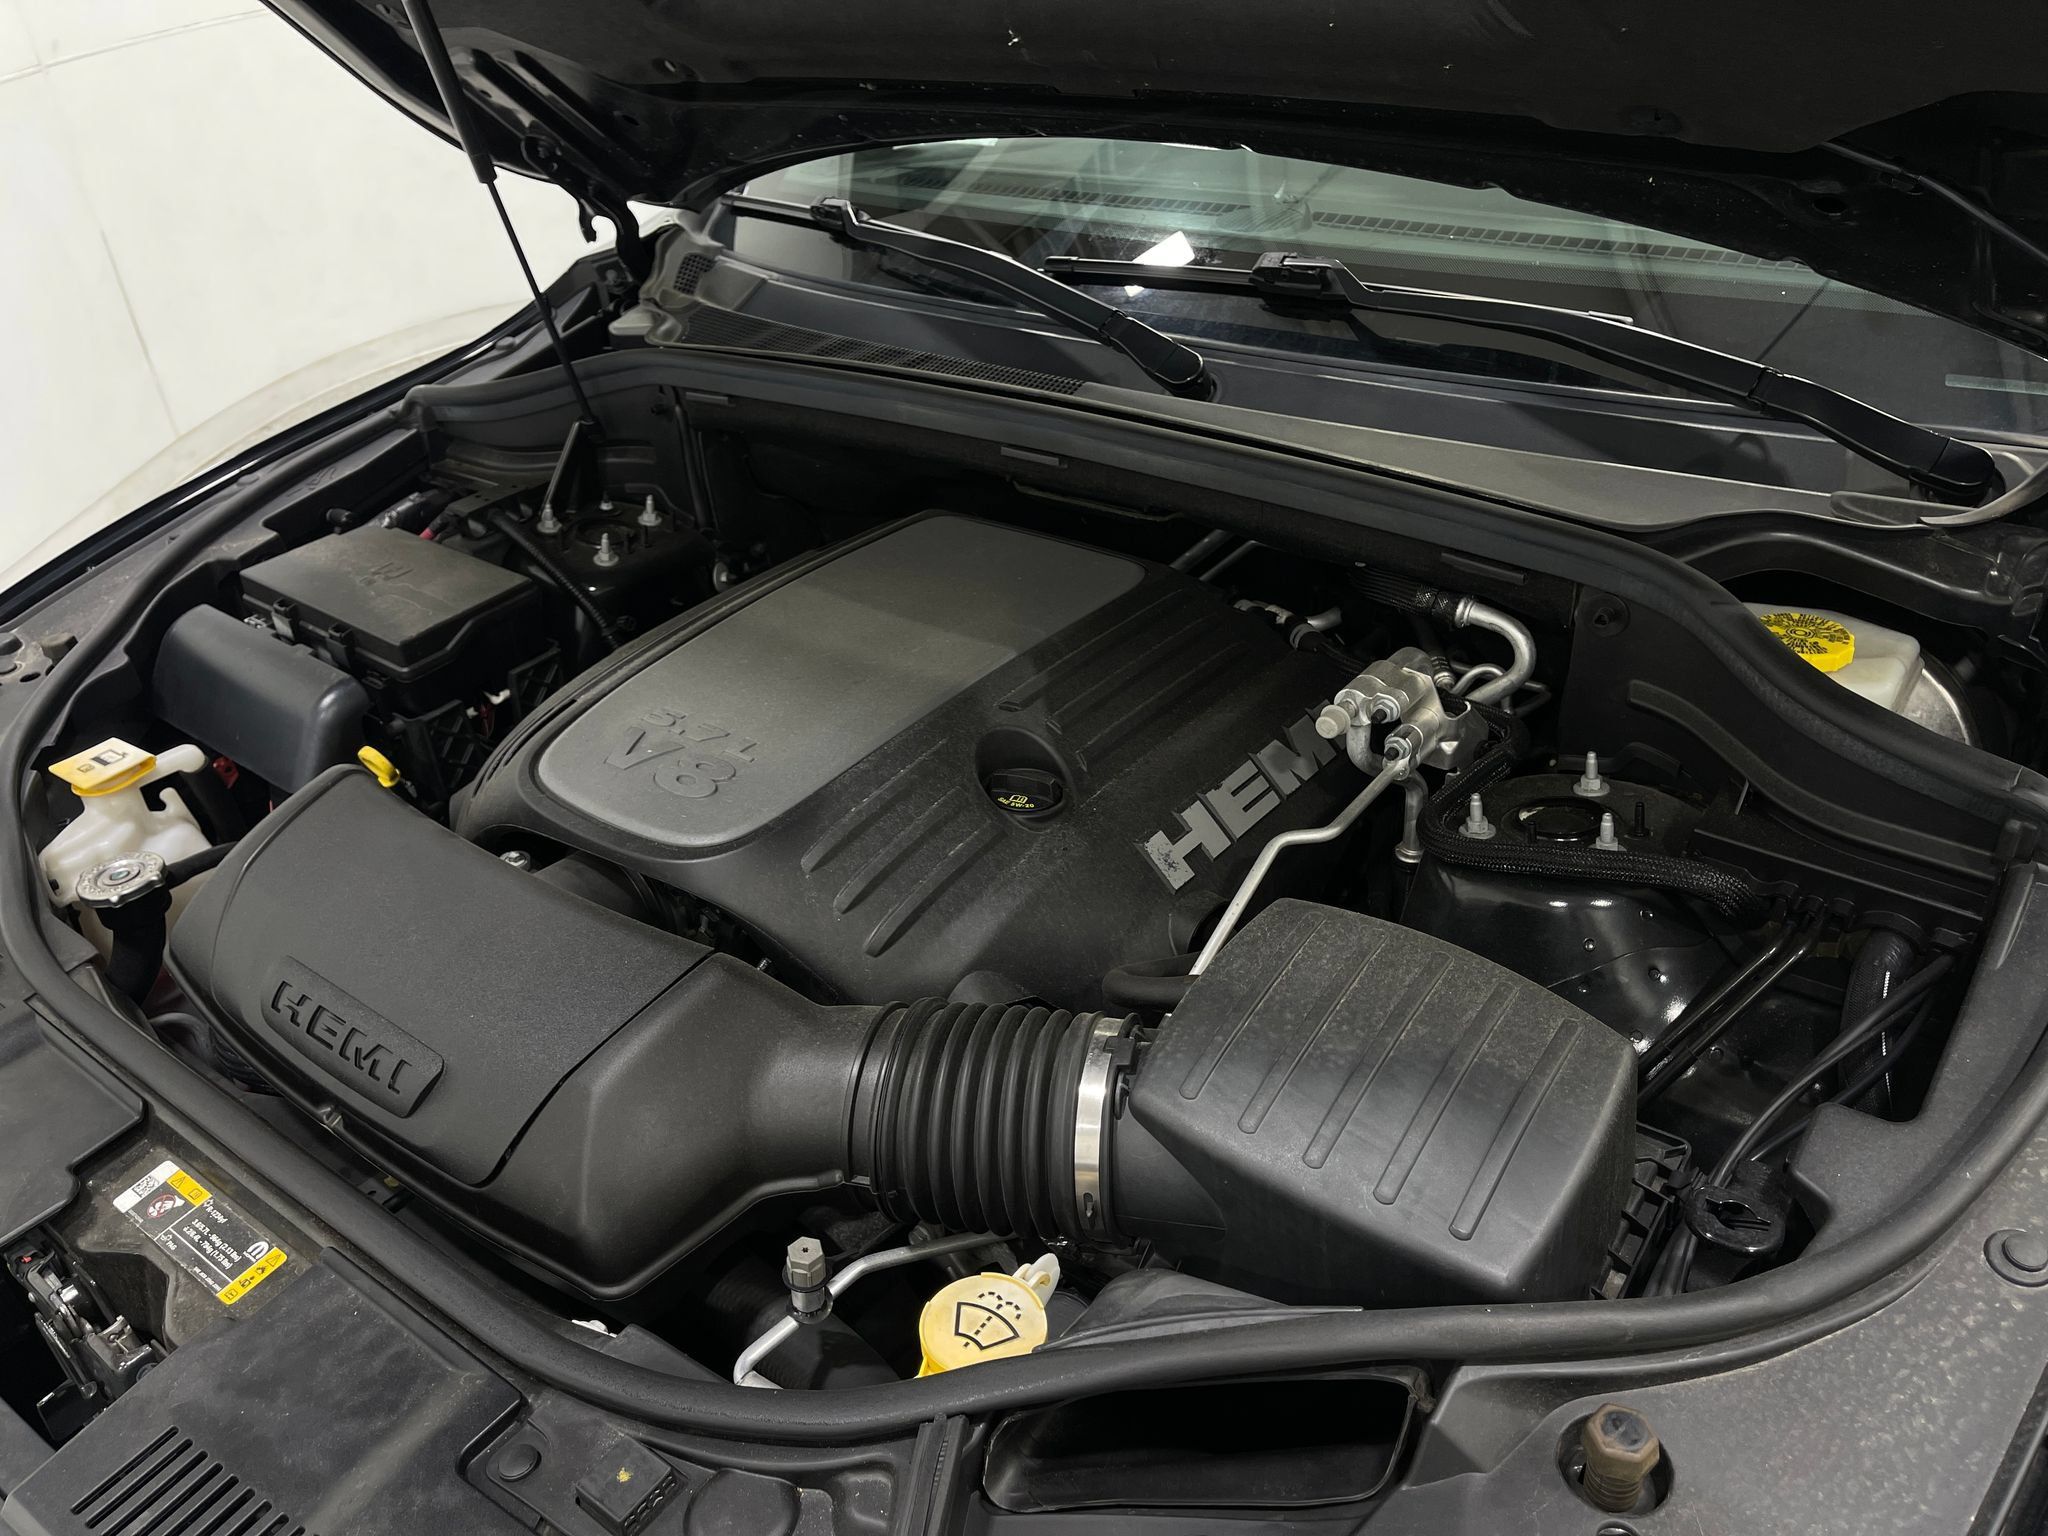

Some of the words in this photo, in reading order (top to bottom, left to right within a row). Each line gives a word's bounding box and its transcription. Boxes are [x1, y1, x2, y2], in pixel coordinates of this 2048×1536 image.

[603, 726, 737, 799] V8
[641, 706, 758, 763] 5.7L
[271, 980, 413, 1095] HEMI
